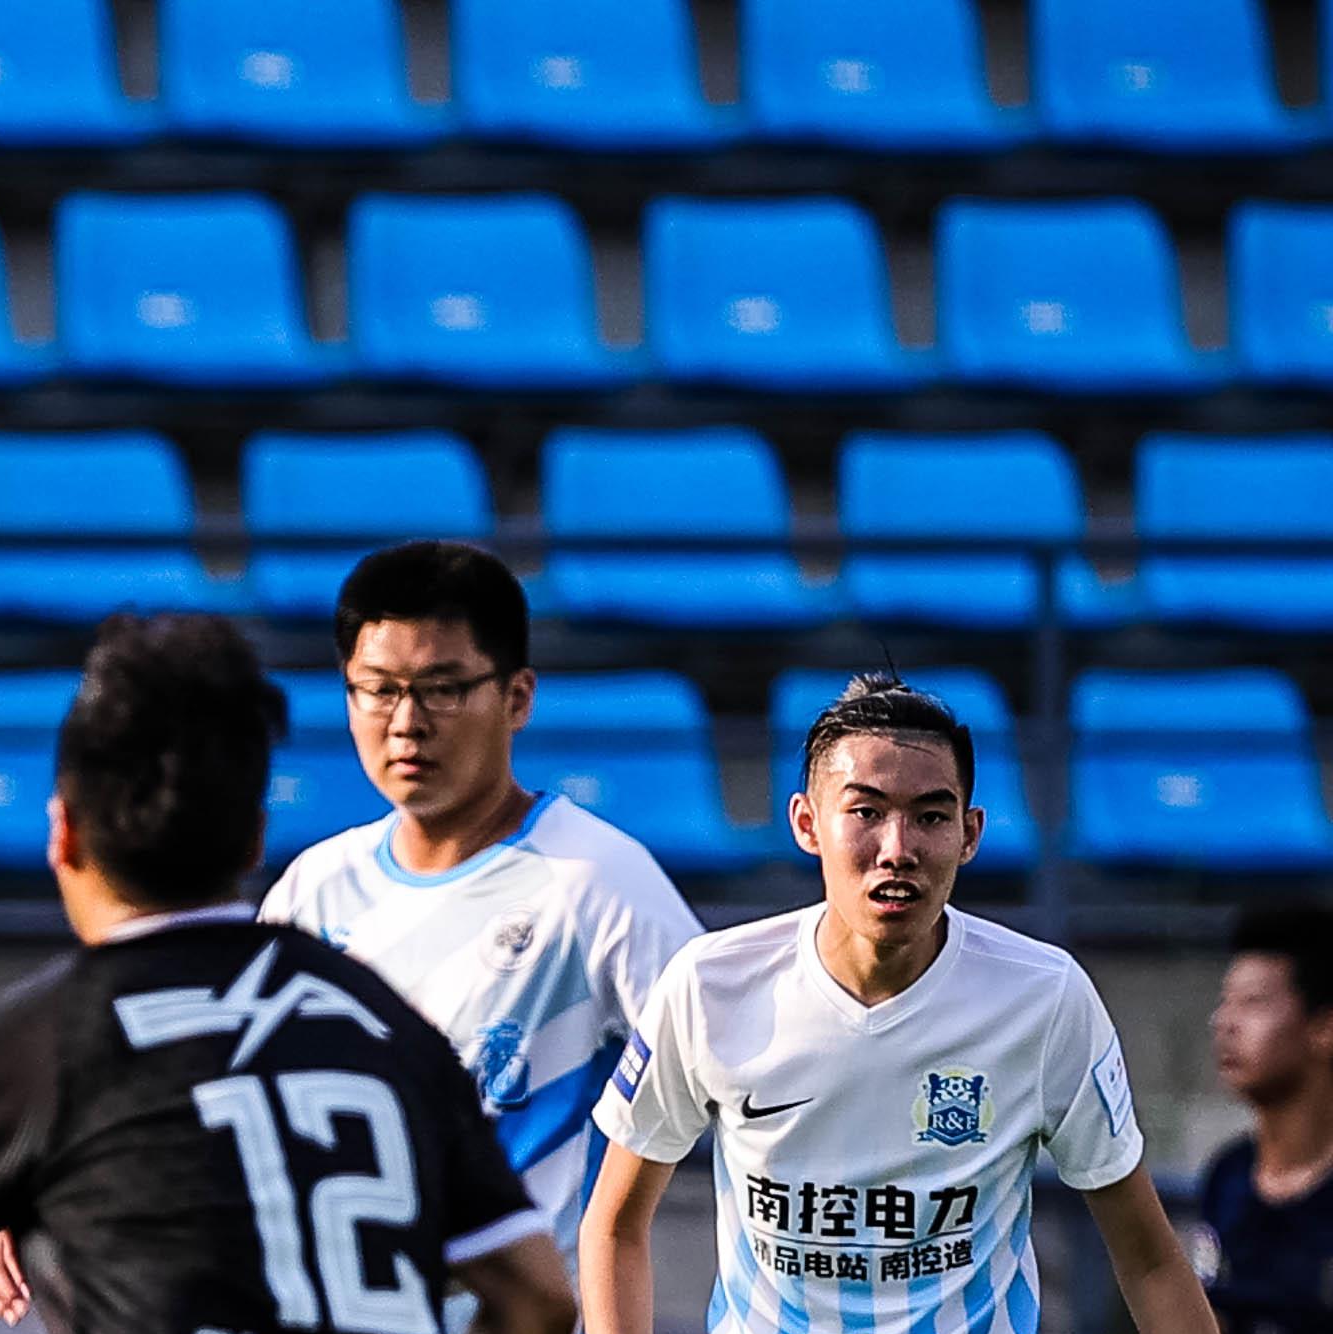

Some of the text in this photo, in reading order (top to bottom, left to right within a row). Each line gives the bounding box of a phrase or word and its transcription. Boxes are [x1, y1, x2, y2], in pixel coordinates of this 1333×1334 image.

[932, 1111, 977, 1131] R&F
[746, 1173, 979, 1240] 南控电力
[879, 1238, 974, 1283] 南控造
